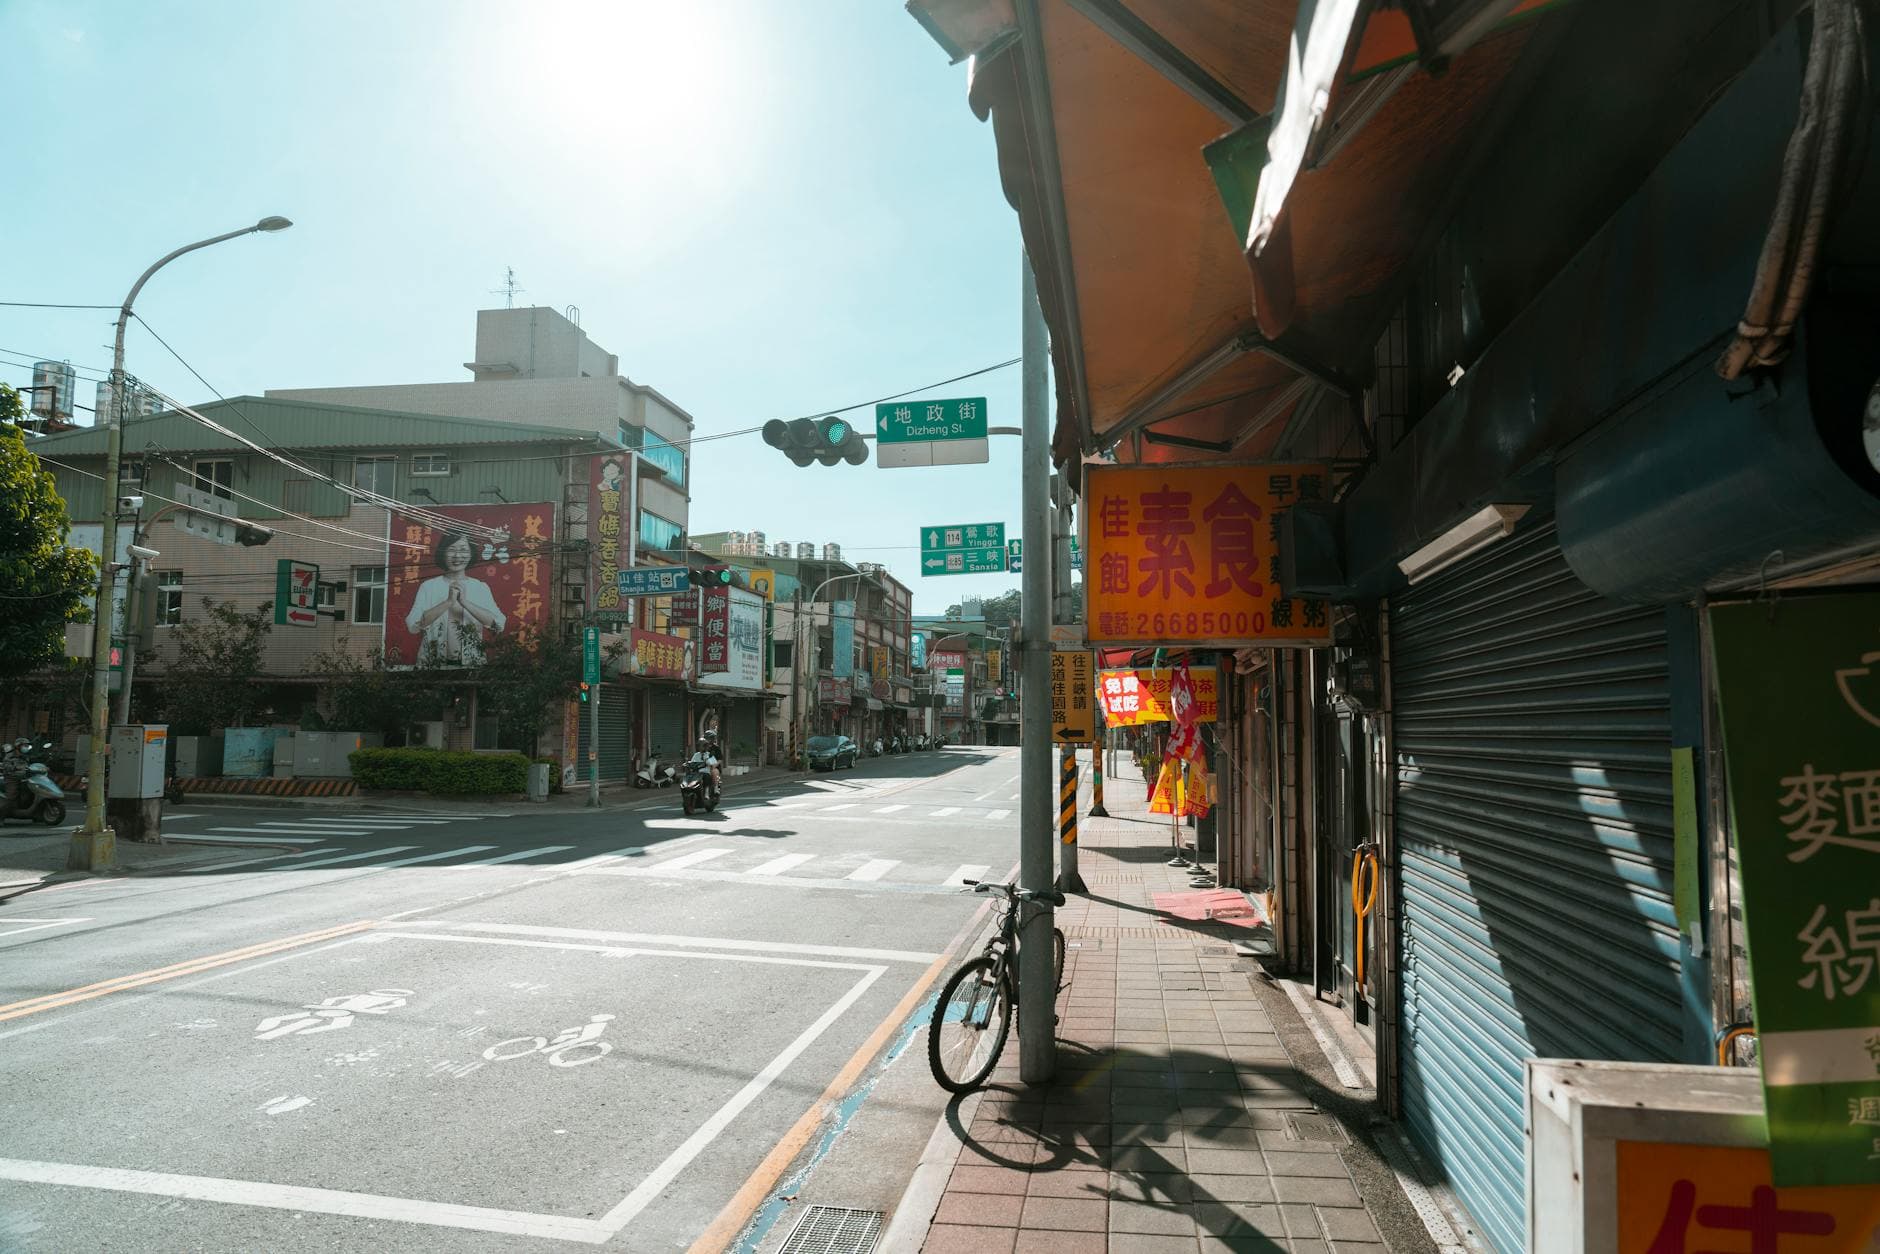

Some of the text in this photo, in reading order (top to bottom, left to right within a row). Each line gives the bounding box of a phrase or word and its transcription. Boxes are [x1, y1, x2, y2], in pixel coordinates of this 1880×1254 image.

[894, 402, 976, 423] 地政街
[906, 423, 965, 437] Dizheng St.
[946, 533, 961, 543] 114
[968, 538, 998, 549] Yingge
[1137, 482, 1264, 600] 素食
[969, 563, 999, 571] Sanxia
[620, 570, 660, 586] 山佳站
[620, 584, 645, 594] Shanjia
[706, 590, 726, 663] 鄉便當
[1137, 611, 1265, 635] 26685000
[1052, 654, 1067, 724] 改道佳園路
[1072, 654, 1087, 710] 往三峽請
[1105, 676, 1139, 694] 免費
[1152, 679, 1213, 694] 珍茶
[1107, 695, 1139, 713] 試吃
